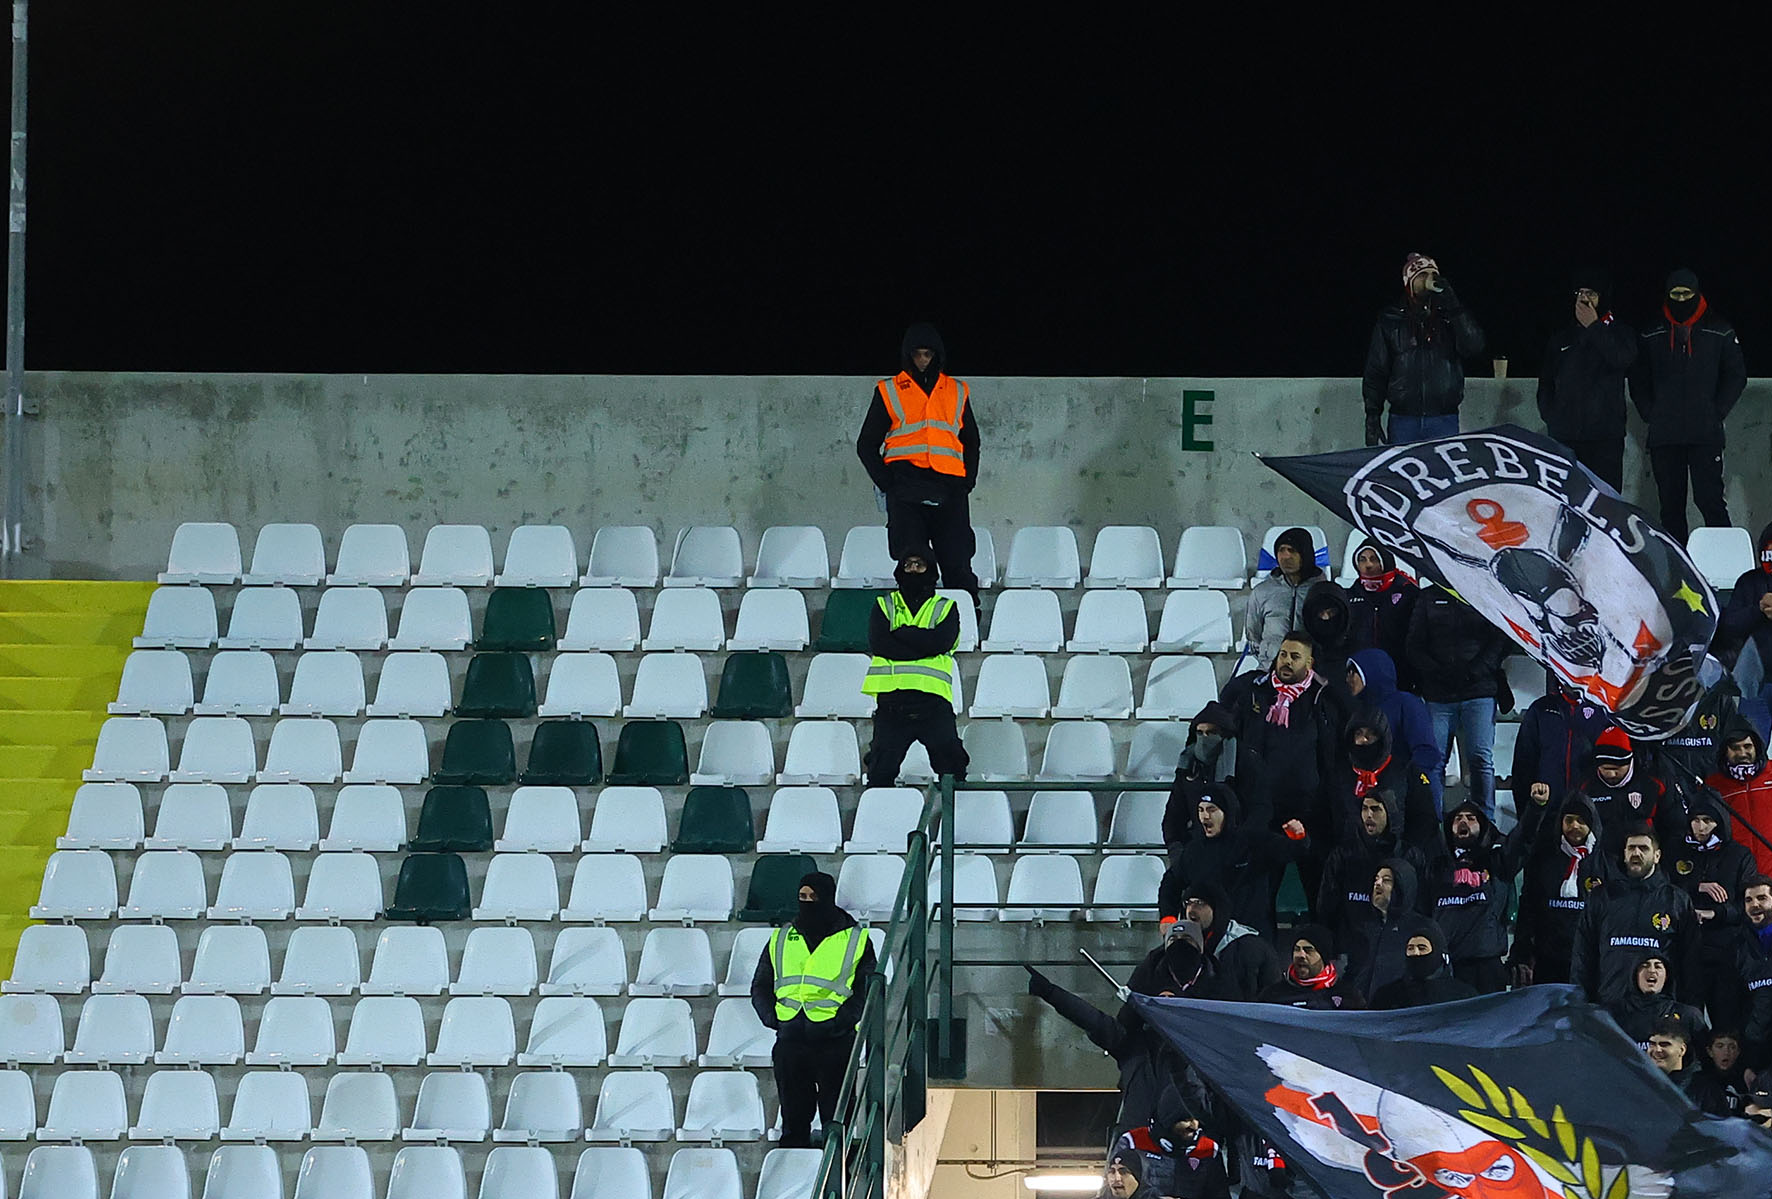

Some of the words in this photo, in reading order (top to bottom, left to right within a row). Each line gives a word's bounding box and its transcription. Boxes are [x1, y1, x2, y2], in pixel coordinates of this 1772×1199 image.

[1182, 390, 1215, 452] E
[1388, 441, 1646, 554] REBELS
[1610, 936, 1660, 950] FAMAGUSTA
